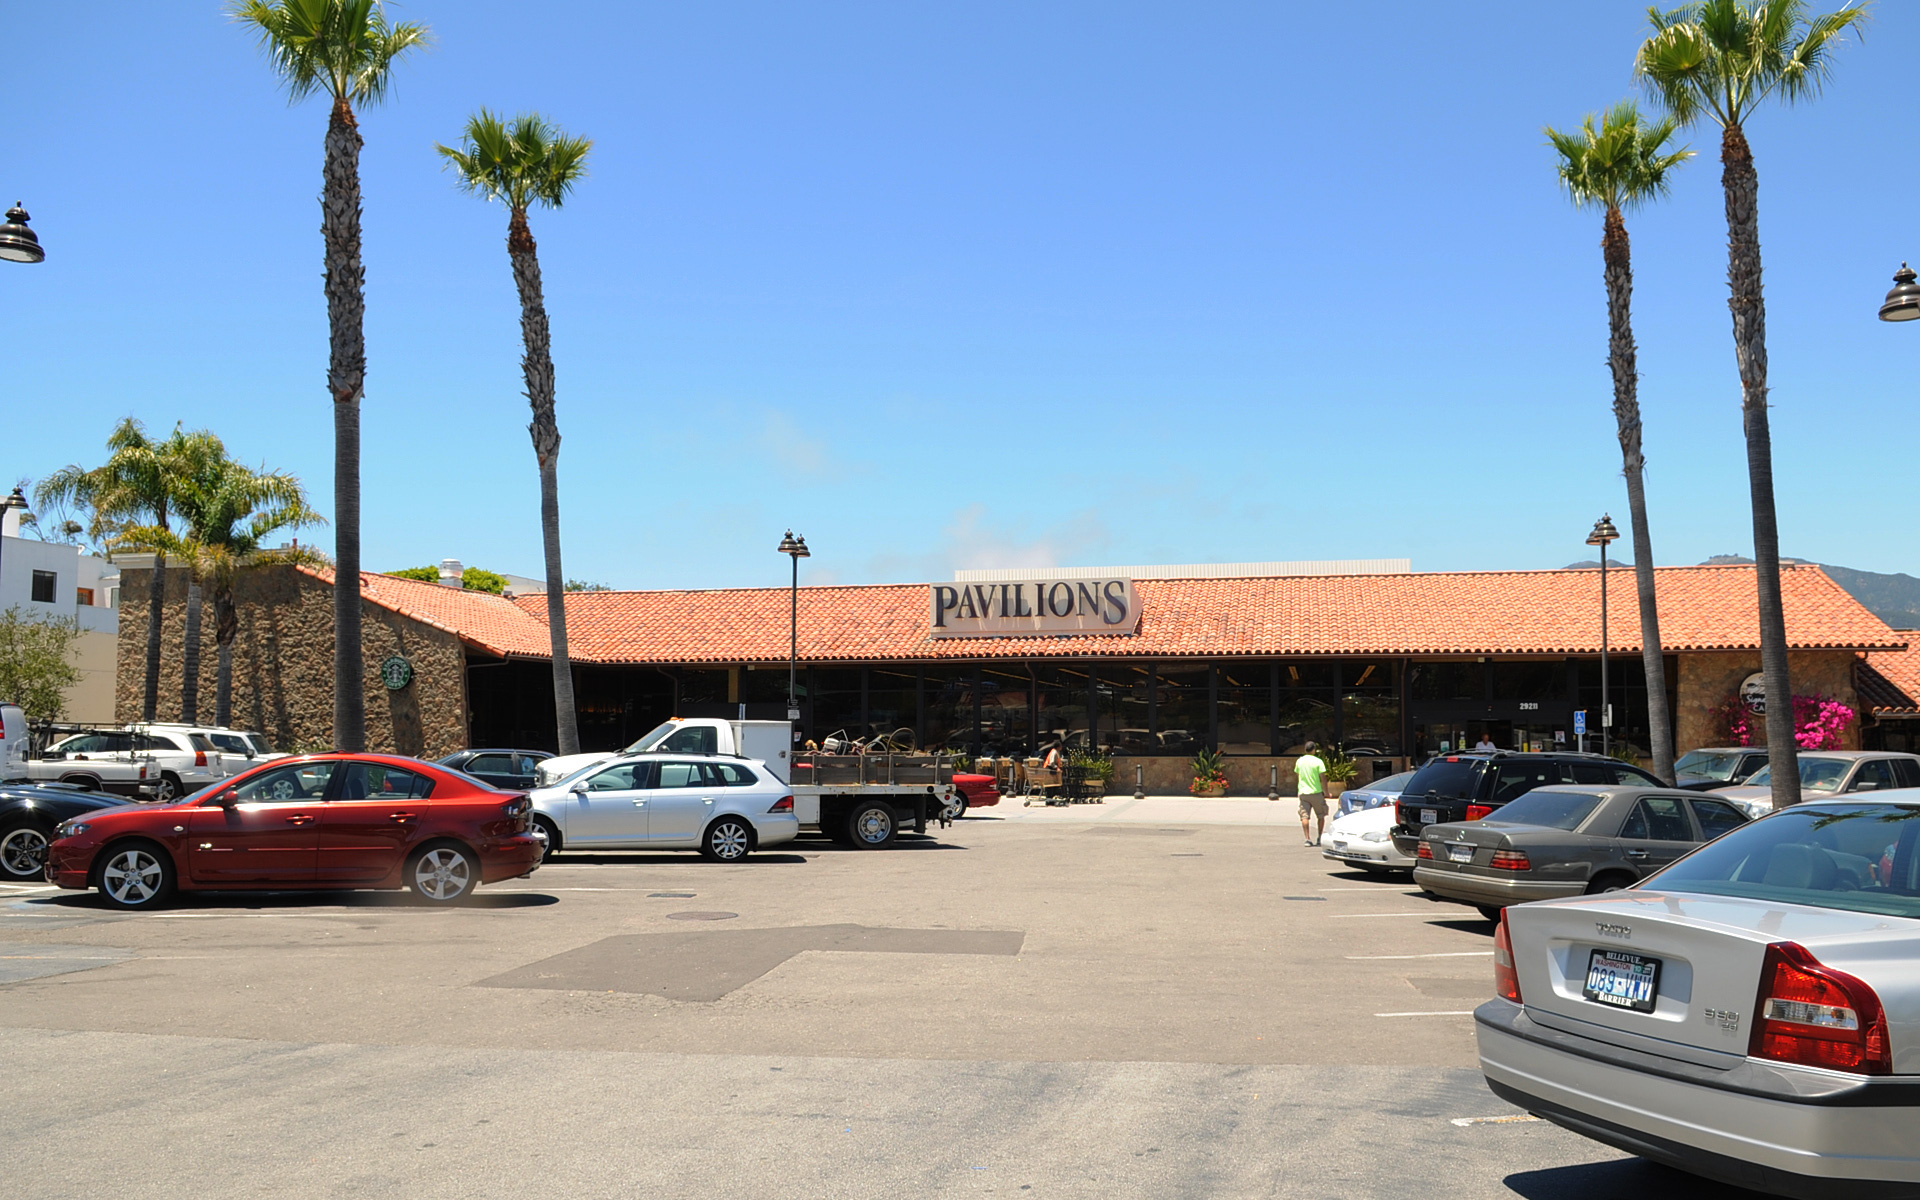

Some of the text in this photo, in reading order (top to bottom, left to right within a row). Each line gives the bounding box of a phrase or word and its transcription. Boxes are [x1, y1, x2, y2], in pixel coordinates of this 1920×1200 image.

[932, 580, 1127, 628] PAVILIONS
[382, 658, 409, 671] STARBUCKS
[385, 678, 405, 687] COFFEE
[1606, 952, 1641, 964] BELLEVUE
[1595, 959, 1631, 970] WASHINGTON
[1598, 992, 1632, 1007] BARRIER
